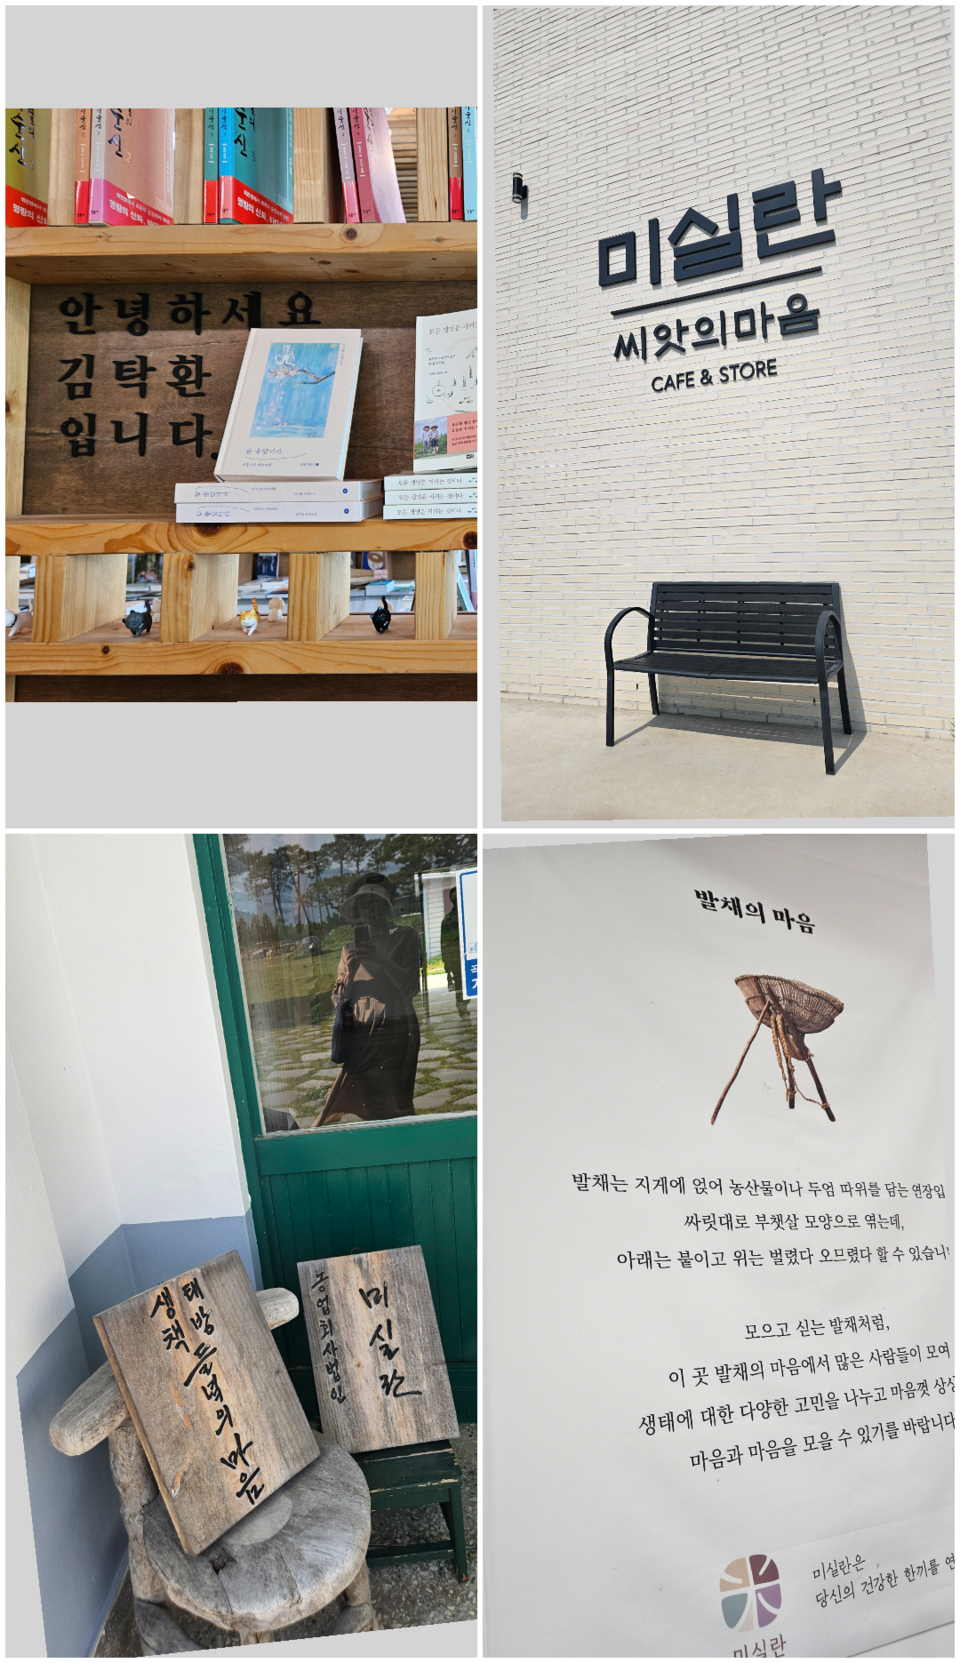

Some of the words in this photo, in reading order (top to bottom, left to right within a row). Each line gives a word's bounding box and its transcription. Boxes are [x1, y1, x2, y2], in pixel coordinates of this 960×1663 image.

[599, 168, 842, 287] 미실란
[59, 291, 322, 337] 안녕하세요
[58, 353, 213, 401] 김탁환
[652, 371, 695, 393] CAFE
[700, 369, 713, 386] &
[720, 358, 778, 383] STORE
[694, 890, 765, 924] 발채의
[772, 908, 815, 934] 마음
[572, 1173, 628, 1192] 발채는
[635, 1176, 685, 1194] 지게에
[729, 1179, 803, 1197] 농산물이나
[808, 1182, 835, 1197] 두엄
[840, 1182, 881, 1197] 따위를
[884, 1182, 908, 1198] 담는
[912, 1183, 945, 1199] 연장입
[684, 1213, 750, 1231] 싸릿대로
[755, 1214, 799, 1230] 부챗살
[805, 1213, 861, 1230] 모양으로
[617, 1250, 671, 1270] 아래는
[677, 1250, 726, 1268] 붙이고
[733, 1249, 764, 1267] 위는
[769, 1248, 813, 1265] 벌렸다
[819, 1247, 872, 1263] 오므렸다
[876, 1246, 888, 1262] 할
[893, 1247, 905, 1262] 수
[909, 1244, 949, 1261] 있습니
[358, 1281, 423, 1398] 미실란
[745, 1323, 791, 1339] 모으고
[796, 1319, 825, 1337] 싣는
[829, 1314, 889, 1334] 발채처럼,
[669, 1368, 685, 1388] 이
[692, 1367, 709, 1387] 곳
[715, 1360, 764, 1383] 발채의
[770, 1354, 830, 1377] 마음에서
[834, 1352, 864, 1371] 많은
[869, 1345, 921, 1366] 사람들이
[927, 1342, 950, 1359] 모여
[639, 1409, 693, 1436] 생태에
[700, 1404, 734, 1426] 대한
[739, 1398, 789, 1421] 다양한
[795, 1392, 839, 1413] 고민을
[844, 1387, 887, 1407] 나누고
[890, 1379, 930, 1400] 마음껏
[690, 1445, 743, 1472] 마음과
[748, 1438, 797, 1461] 마음을
[803, 1432, 833, 1452] 모을
[838, 1429, 852, 1447] 수
[858, 1422, 899, 1444] 있기를
[903, 1412, 955, 1436] 바랍니다
[813, 1554, 866, 1581] 미실란은
[816, 1581, 856, 1608] 당신의
[861, 1570, 898, 1596] 건강한
[904, 1558, 940, 1583] 한끼를
